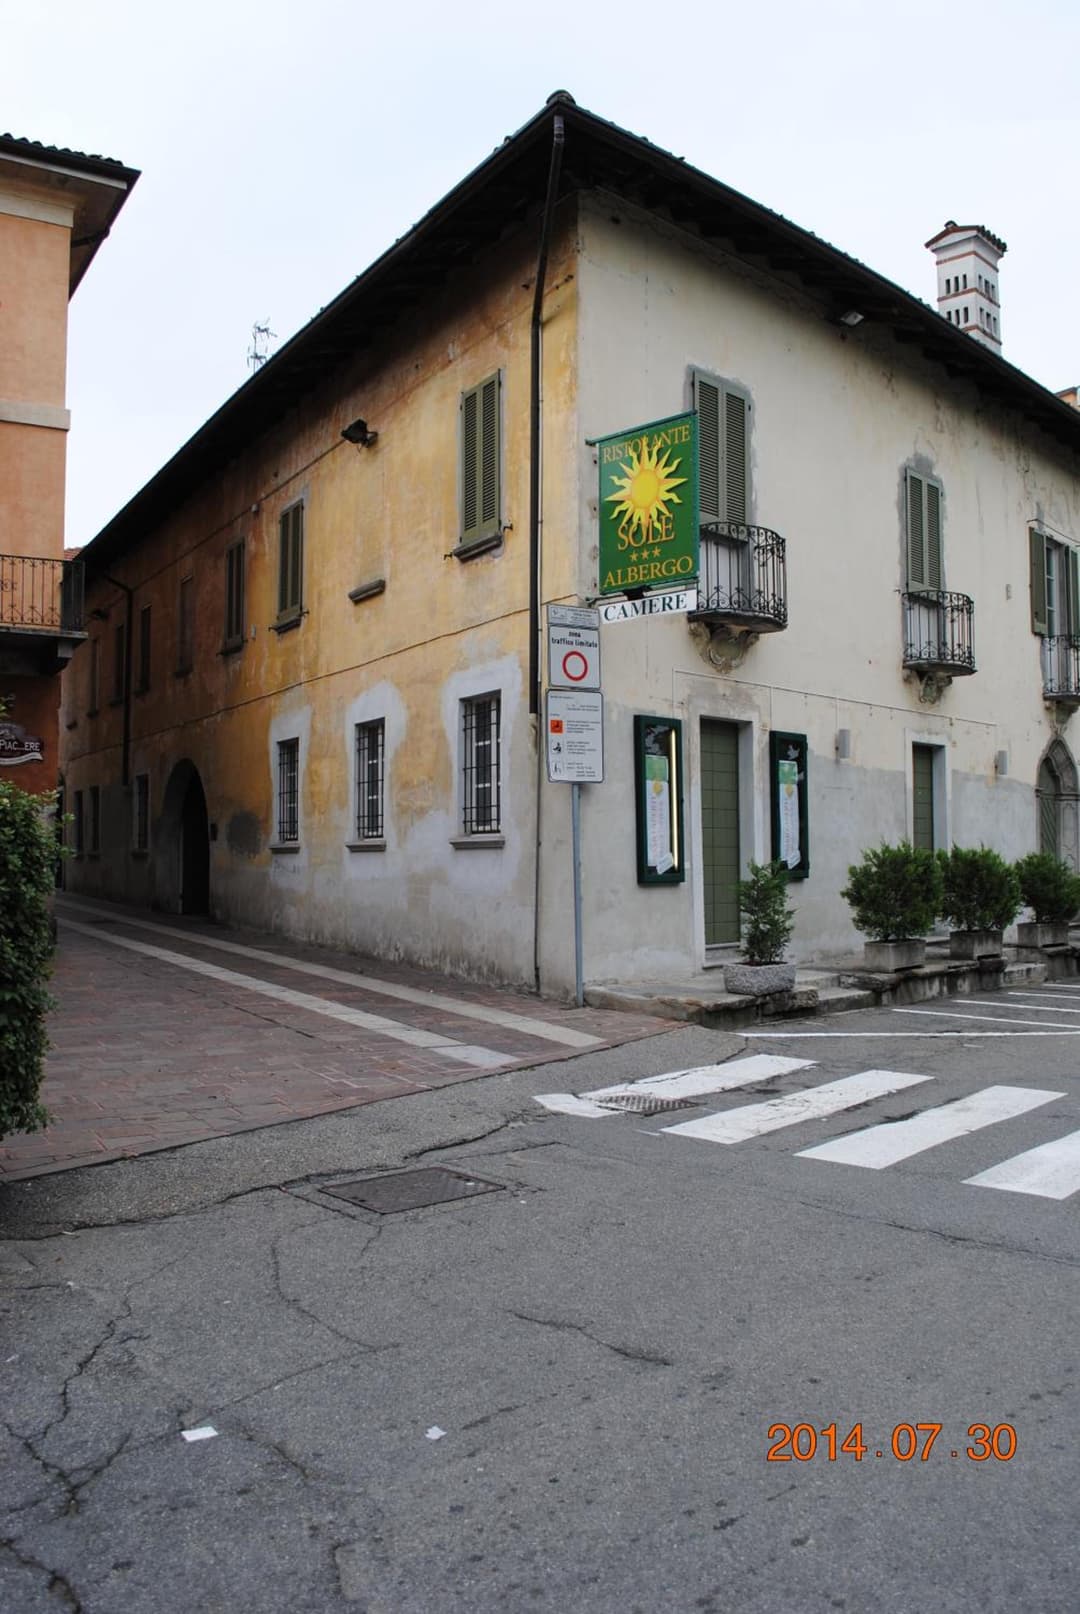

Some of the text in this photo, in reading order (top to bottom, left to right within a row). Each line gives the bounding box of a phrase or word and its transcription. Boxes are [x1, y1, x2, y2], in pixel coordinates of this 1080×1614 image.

[618, 514, 675, 550] SOLE
[603, 556, 693, 588] ALBERGO
[604, 593, 687, 621] CAMERE
[551, 637, 598, 648] traffico limitato
